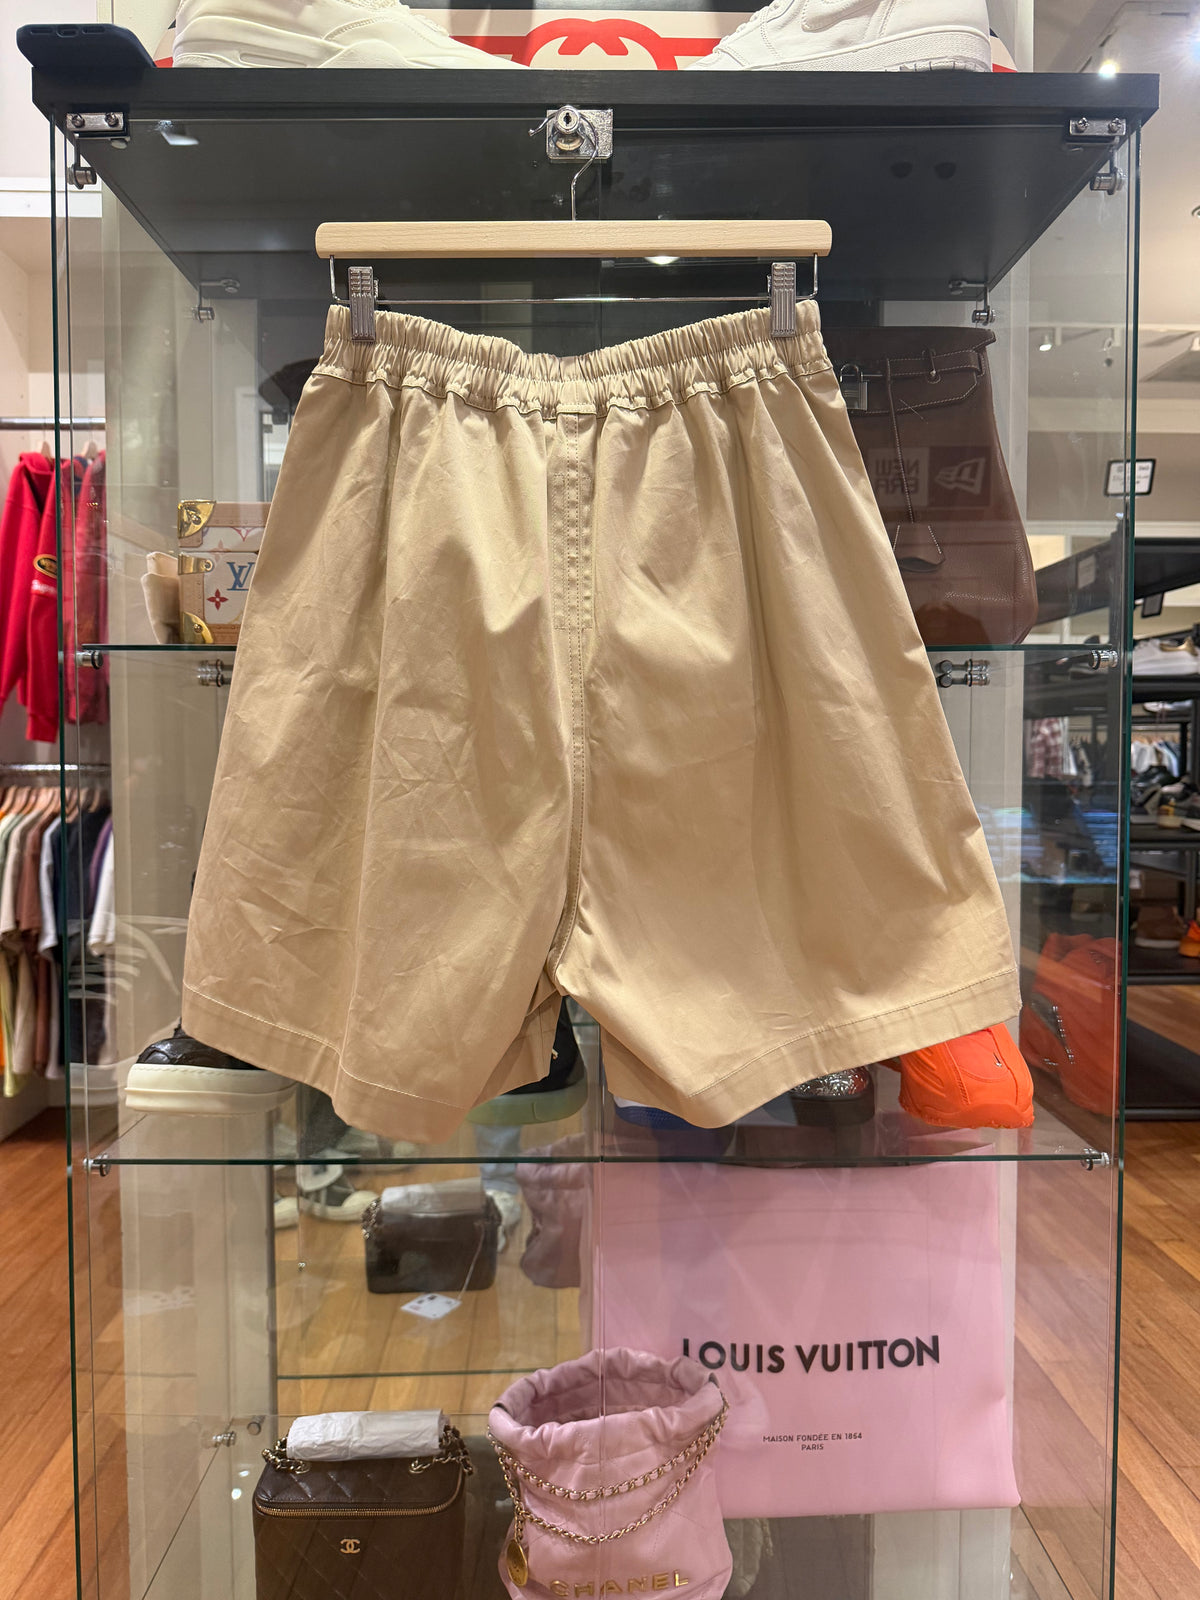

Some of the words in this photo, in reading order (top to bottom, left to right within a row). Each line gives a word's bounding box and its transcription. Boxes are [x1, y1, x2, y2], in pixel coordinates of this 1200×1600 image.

[795, 1335, 940, 1373] VUITTON
[831, 1433, 842, 1441] EN
[801, 1443, 824, 1451] PARIS
[551, 1569, 689, 1598] CHANEL
